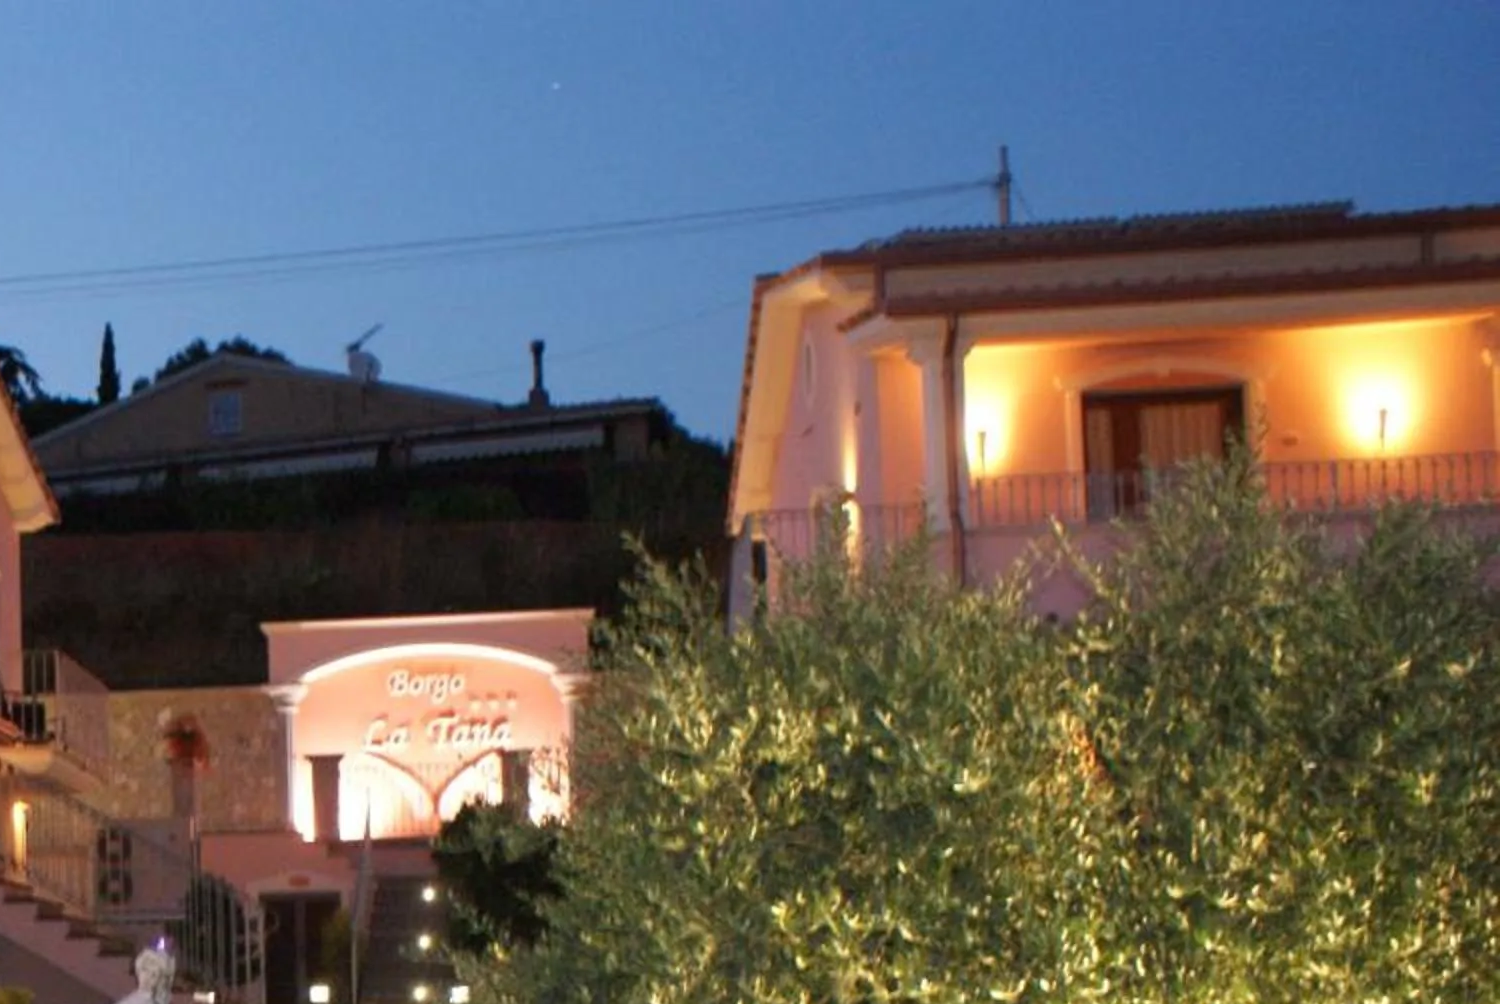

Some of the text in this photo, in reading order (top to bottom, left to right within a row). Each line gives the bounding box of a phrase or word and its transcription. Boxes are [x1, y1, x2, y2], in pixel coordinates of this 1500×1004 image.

[388, 668, 465, 703] Borgo
[364, 714, 513, 752] La Tana
